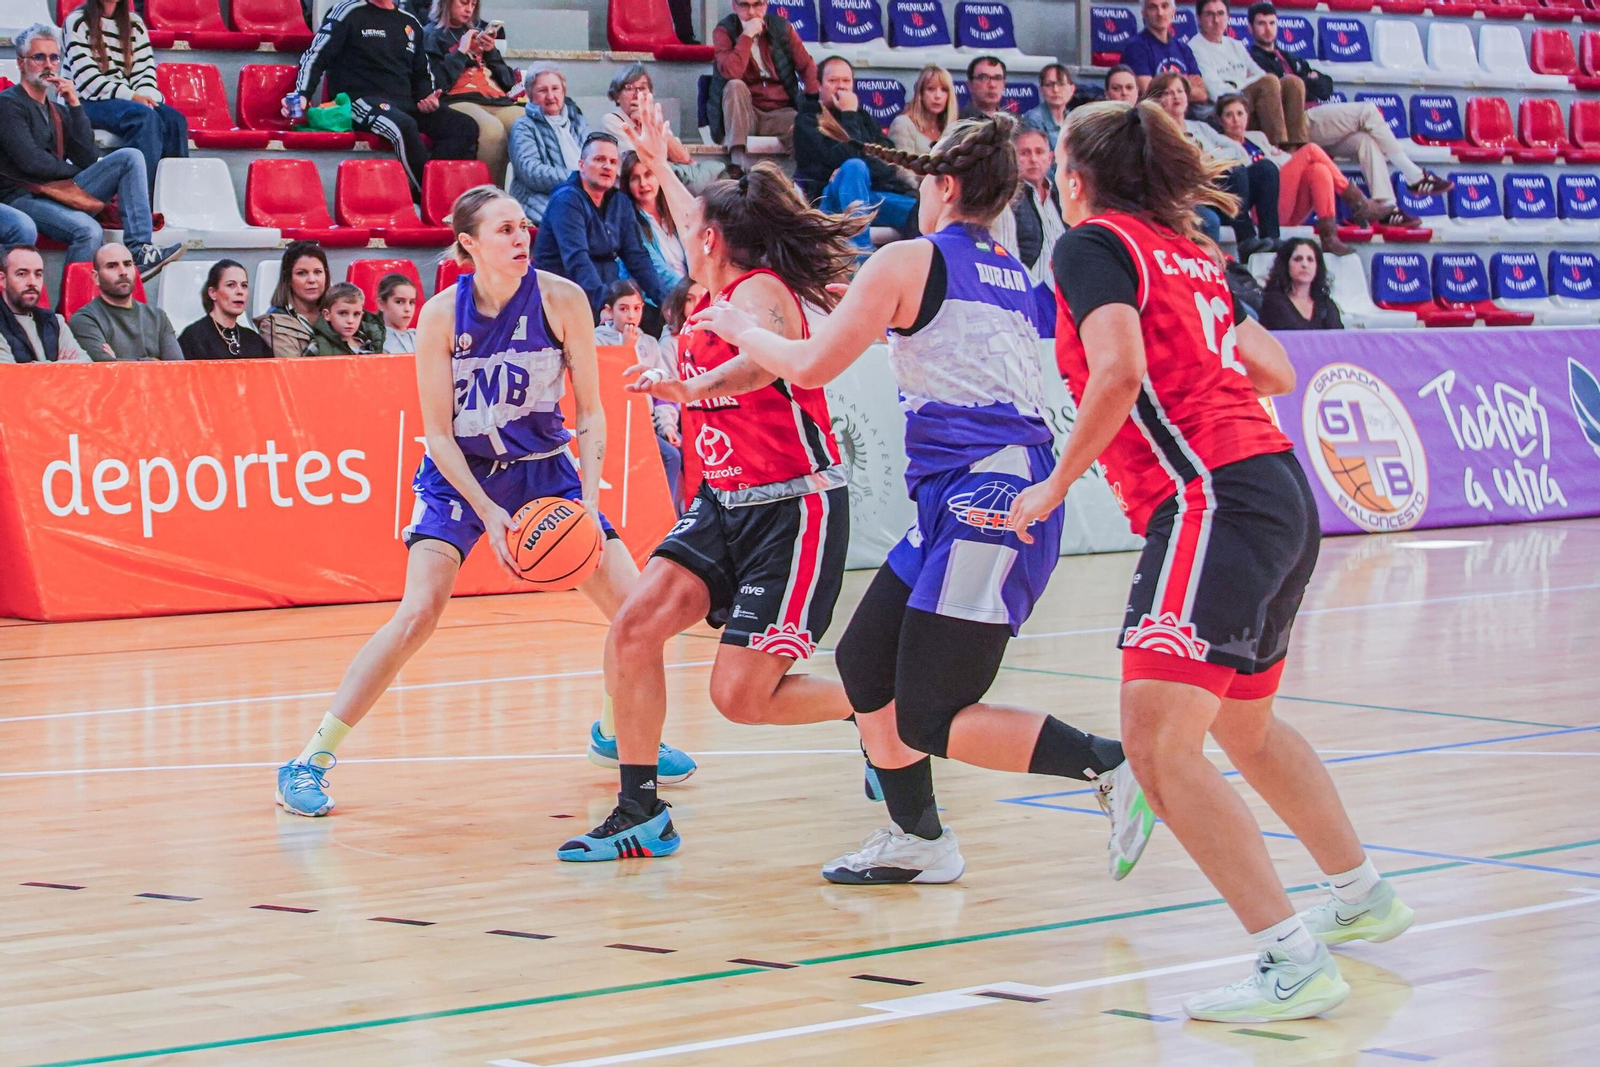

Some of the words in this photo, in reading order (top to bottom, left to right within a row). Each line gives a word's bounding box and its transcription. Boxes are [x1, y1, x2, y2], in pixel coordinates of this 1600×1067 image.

[896, 2, 935, 12] PREMIUM
[964, 5, 1003, 15] PREMIUM
[856, 80, 899, 90] PREMIUM
[1313, 368, 1380, 393] GRANADA
[42, 433, 371, 538] deportes
[1464, 466, 1494, 512] a
[1492, 459, 1567, 514] una
[1336, 491, 1426, 530] BALONCESTO
[523, 504, 575, 551] Wilson
